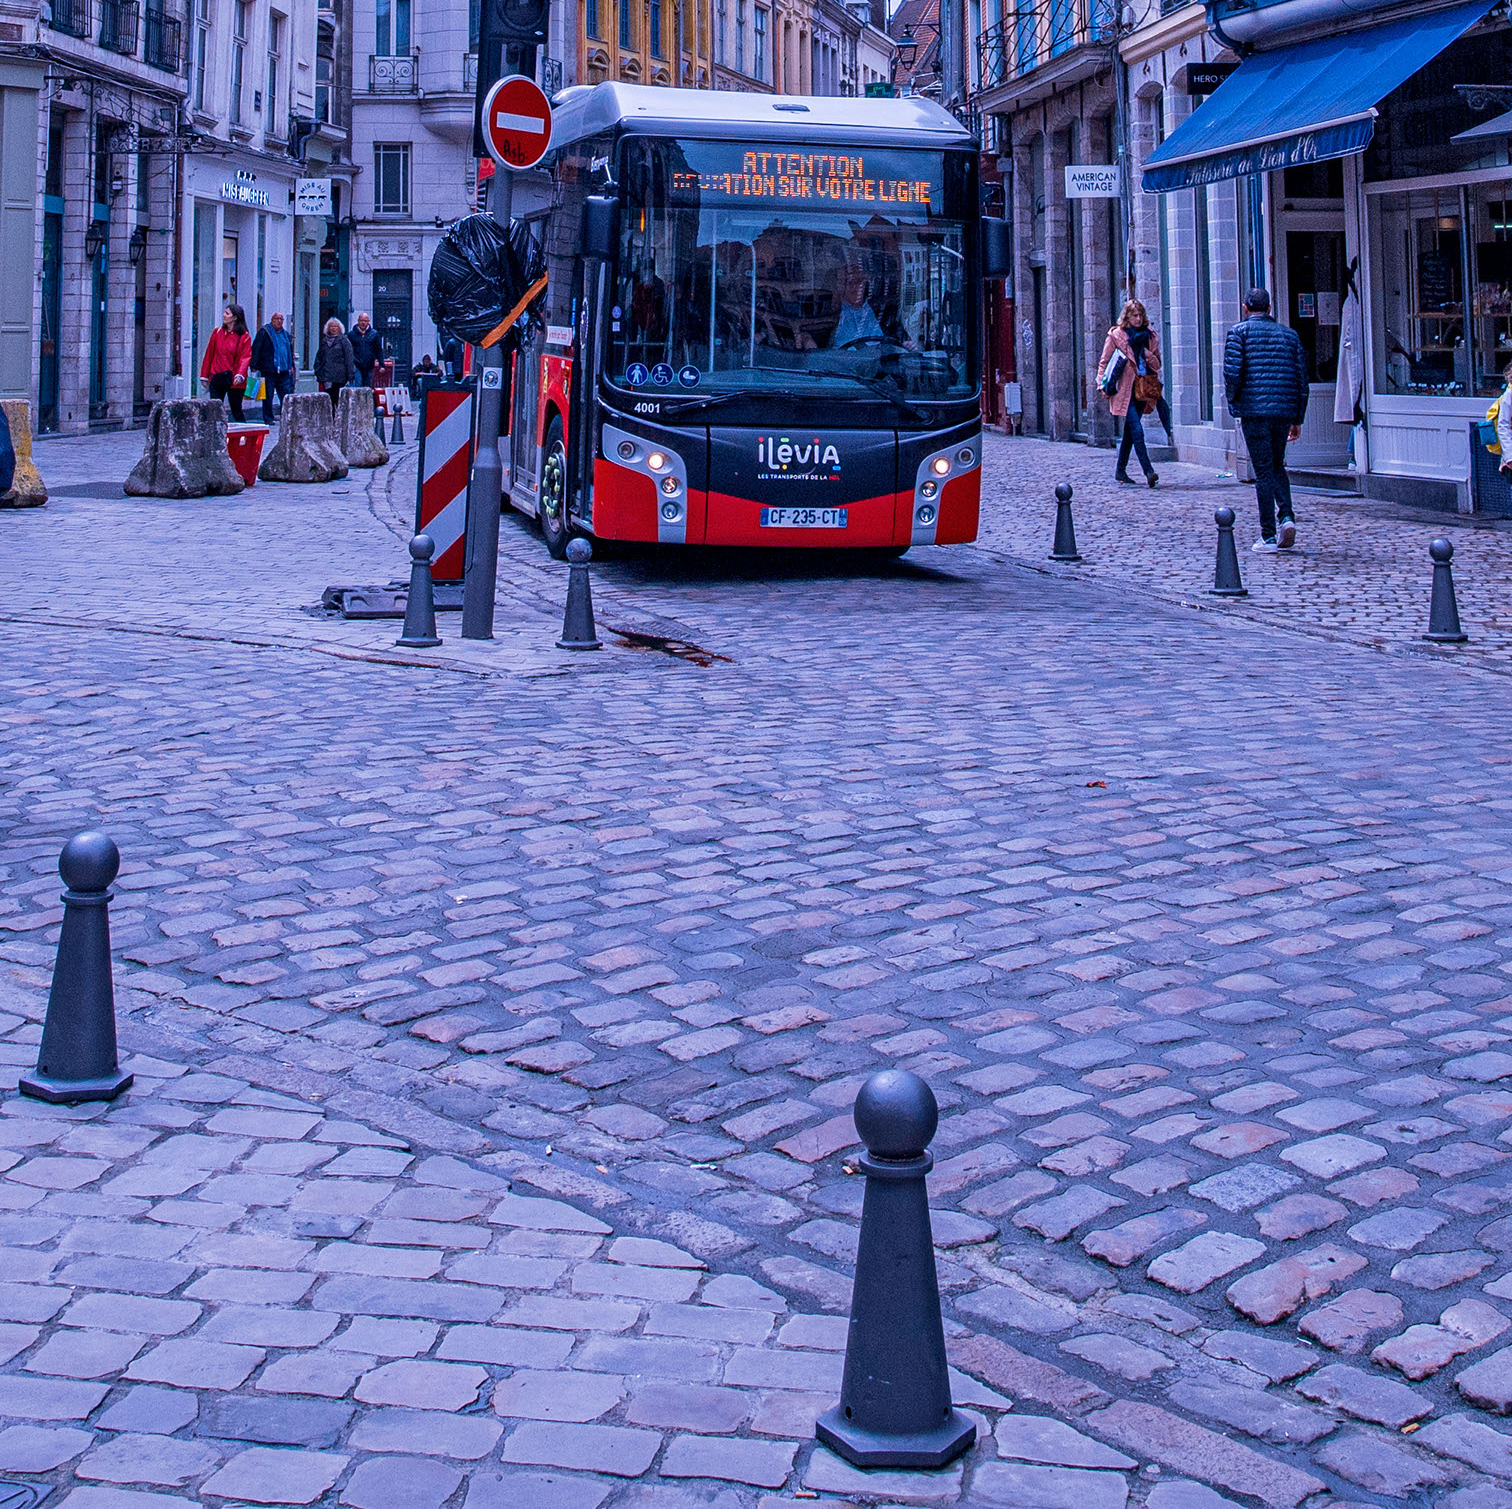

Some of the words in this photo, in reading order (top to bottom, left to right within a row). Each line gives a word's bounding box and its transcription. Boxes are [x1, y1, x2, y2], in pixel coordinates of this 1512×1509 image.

[1193, 74, 1218, 83] HERO
[1257, 144, 1286, 170] Lion
[742, 151, 863, 178] ATTENTION
[1071, 172, 1117, 182] AMERICAN
[300, 182, 316, 194] MISE
[317, 184, 326, 194] AU
[777, 175, 813, 198] SUR
[815, 177, 876, 201] VOTRE
[879, 179, 931, 204] LIGNE
[1076, 182, 1113, 191] VINTAGE
[301, 202, 324, 212] GREEN
[634, 402, 661, 414] 4001
[770, 509, 838, 525] CF-235-CT
